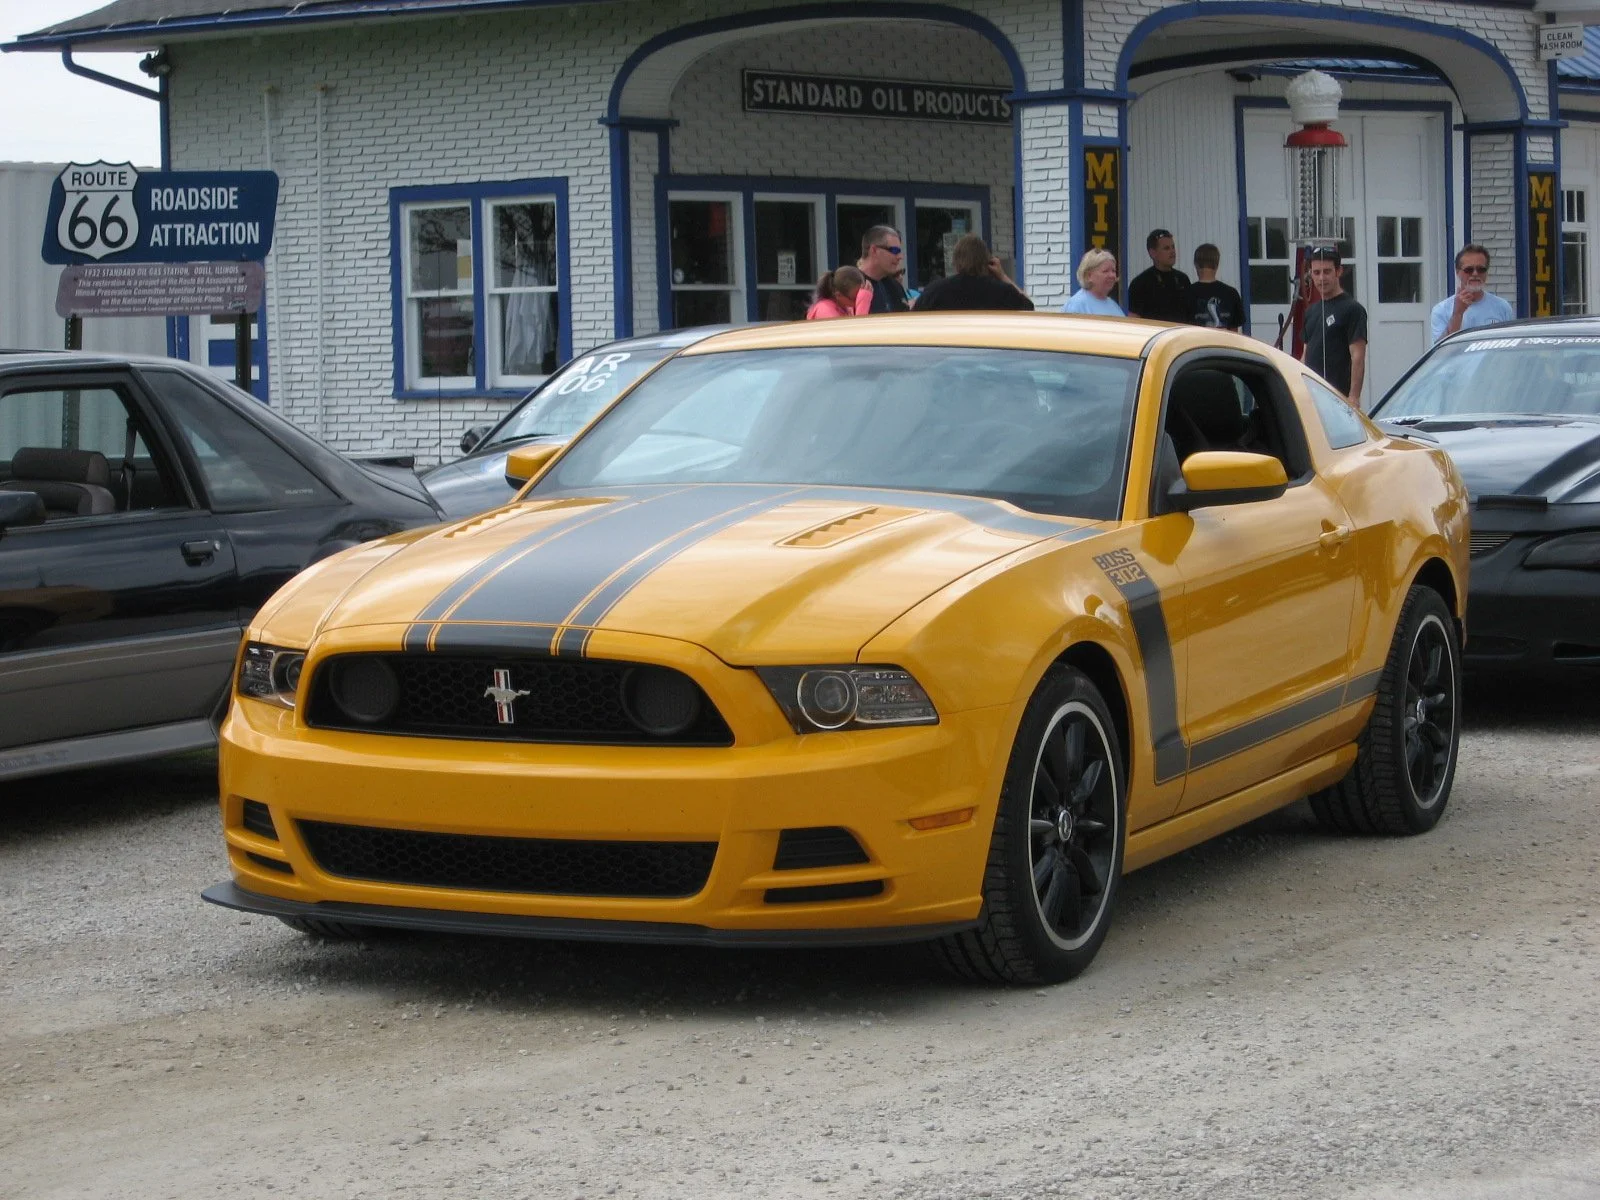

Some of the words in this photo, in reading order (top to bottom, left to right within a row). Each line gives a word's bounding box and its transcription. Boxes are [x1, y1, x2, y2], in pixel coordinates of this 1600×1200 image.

[1546, 32, 1573, 41] CLEAN
[753, 79, 863, 109] STANDARD
[872, 88, 907, 112] OIL
[913, 90, 1011, 118] PRODUCTS
[71, 171, 128, 186] ROUTE
[151, 187, 239, 211] ROADSIDE
[68, 194, 129, 249] 66
[150, 222, 260, 247] ATTRACTION
[102, 267, 136, 277] STANDARD
[136, 267, 147, 276] OIL
[149, 267, 161, 276] GAS
[214, 265, 239, 274] ILLINOIS
[558, 372, 612, 395] 06
[1092, 547, 1136, 571] BOSS
[1108, 563, 1146, 586] 302
